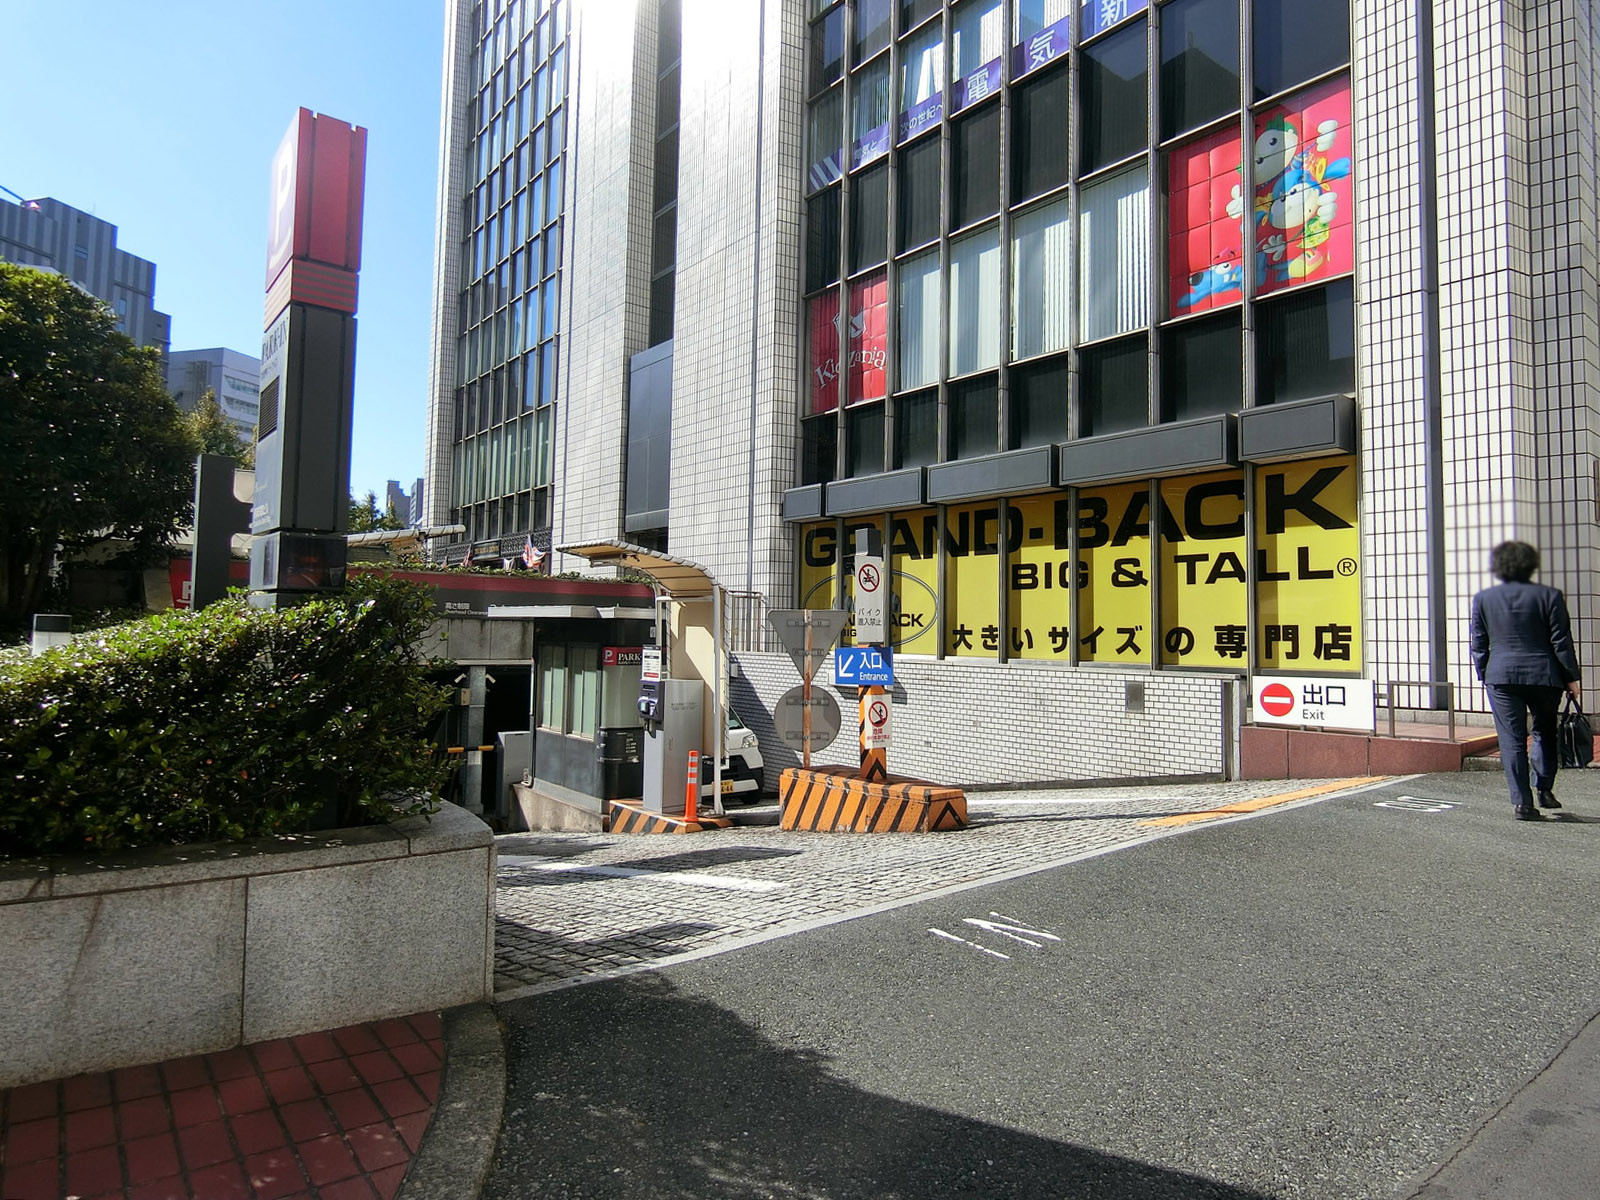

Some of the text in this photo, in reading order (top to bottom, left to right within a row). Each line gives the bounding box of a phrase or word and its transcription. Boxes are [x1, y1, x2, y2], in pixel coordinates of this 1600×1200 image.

[1012, 561, 1089, 590] BIG
[1111, 558, 1149, 588] &
[858, 608, 881, 616] バイク
[952, 622, 1352, 661] 大きいサイズの専門店
[859, 652, 882, 669] 入口
[859, 671, 888, 681] Entrance
[1302, 683, 1346, 706] 出口
[1302, 708, 1325, 720] Exit
